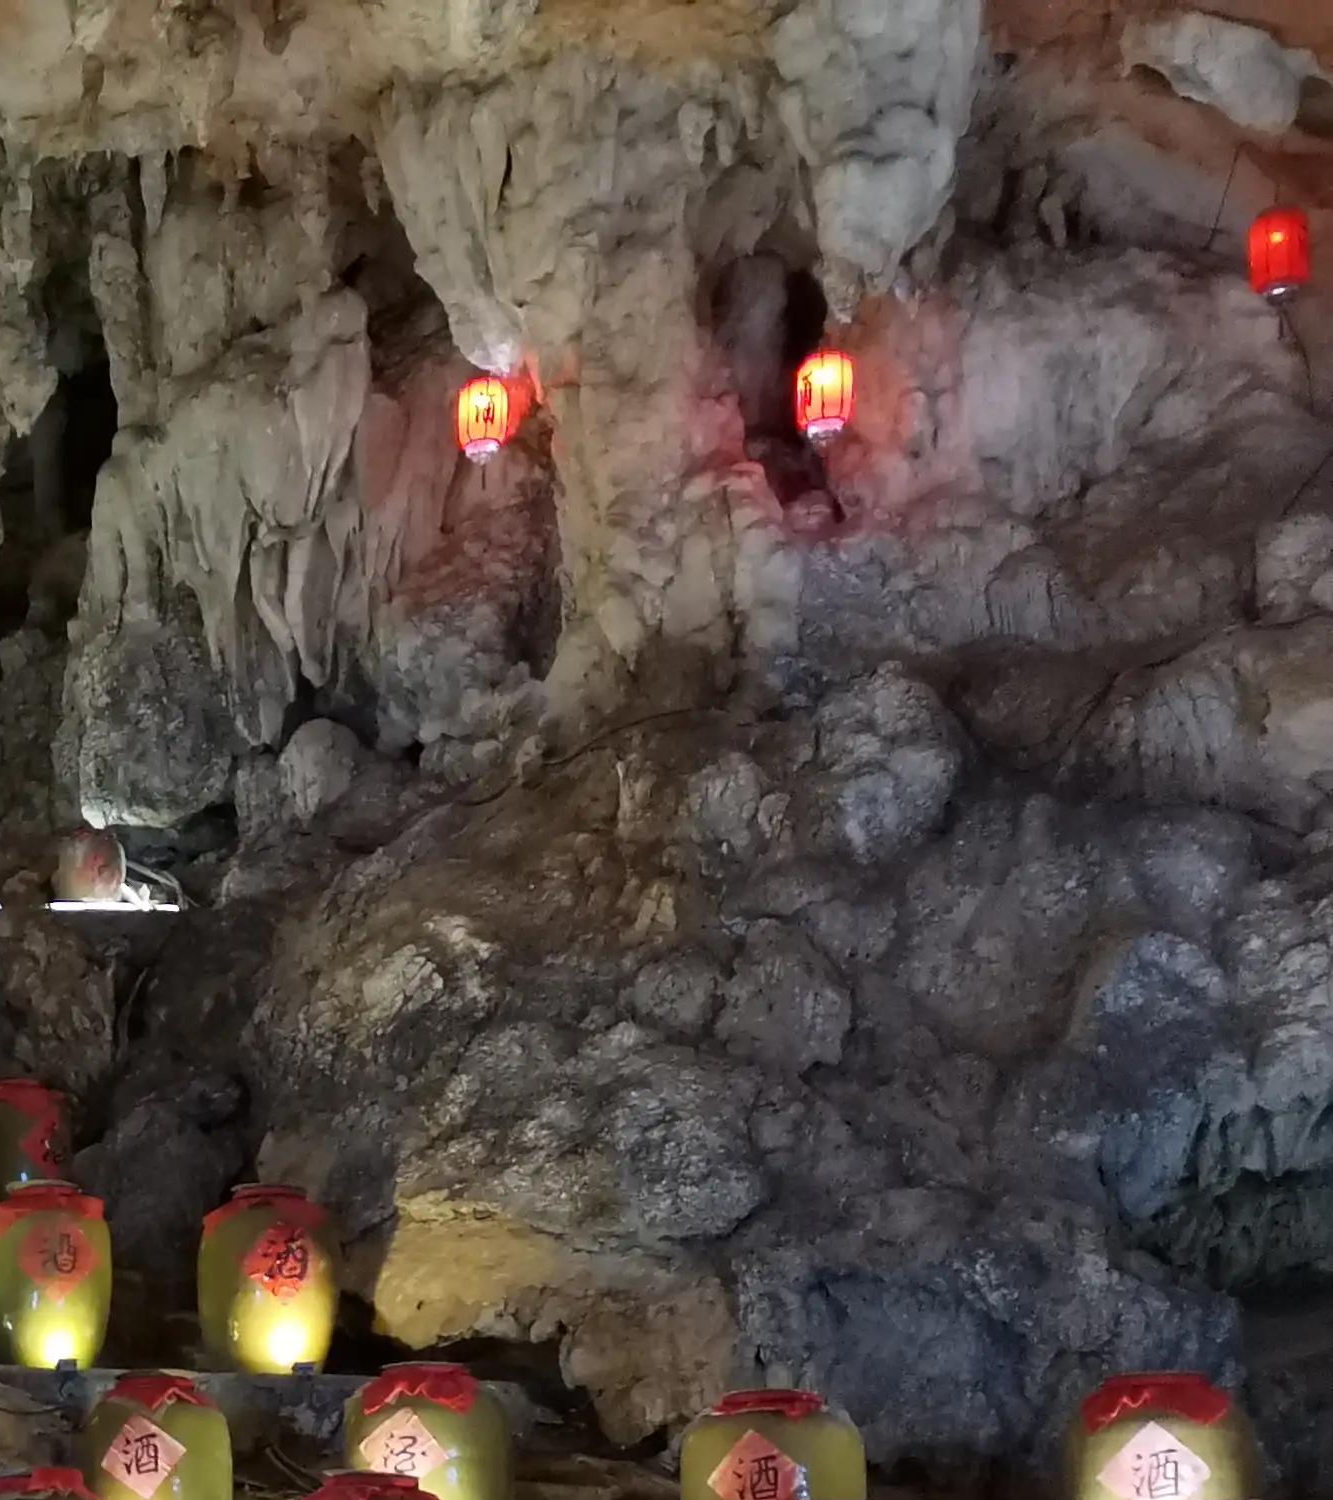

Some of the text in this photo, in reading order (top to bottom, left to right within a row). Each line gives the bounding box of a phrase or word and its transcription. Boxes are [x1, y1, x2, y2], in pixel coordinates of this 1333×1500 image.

[121, 1432, 160, 1476] 酒
[732, 1453, 780, 1500] 酒
[1136, 1448, 1180, 1499] 酒
